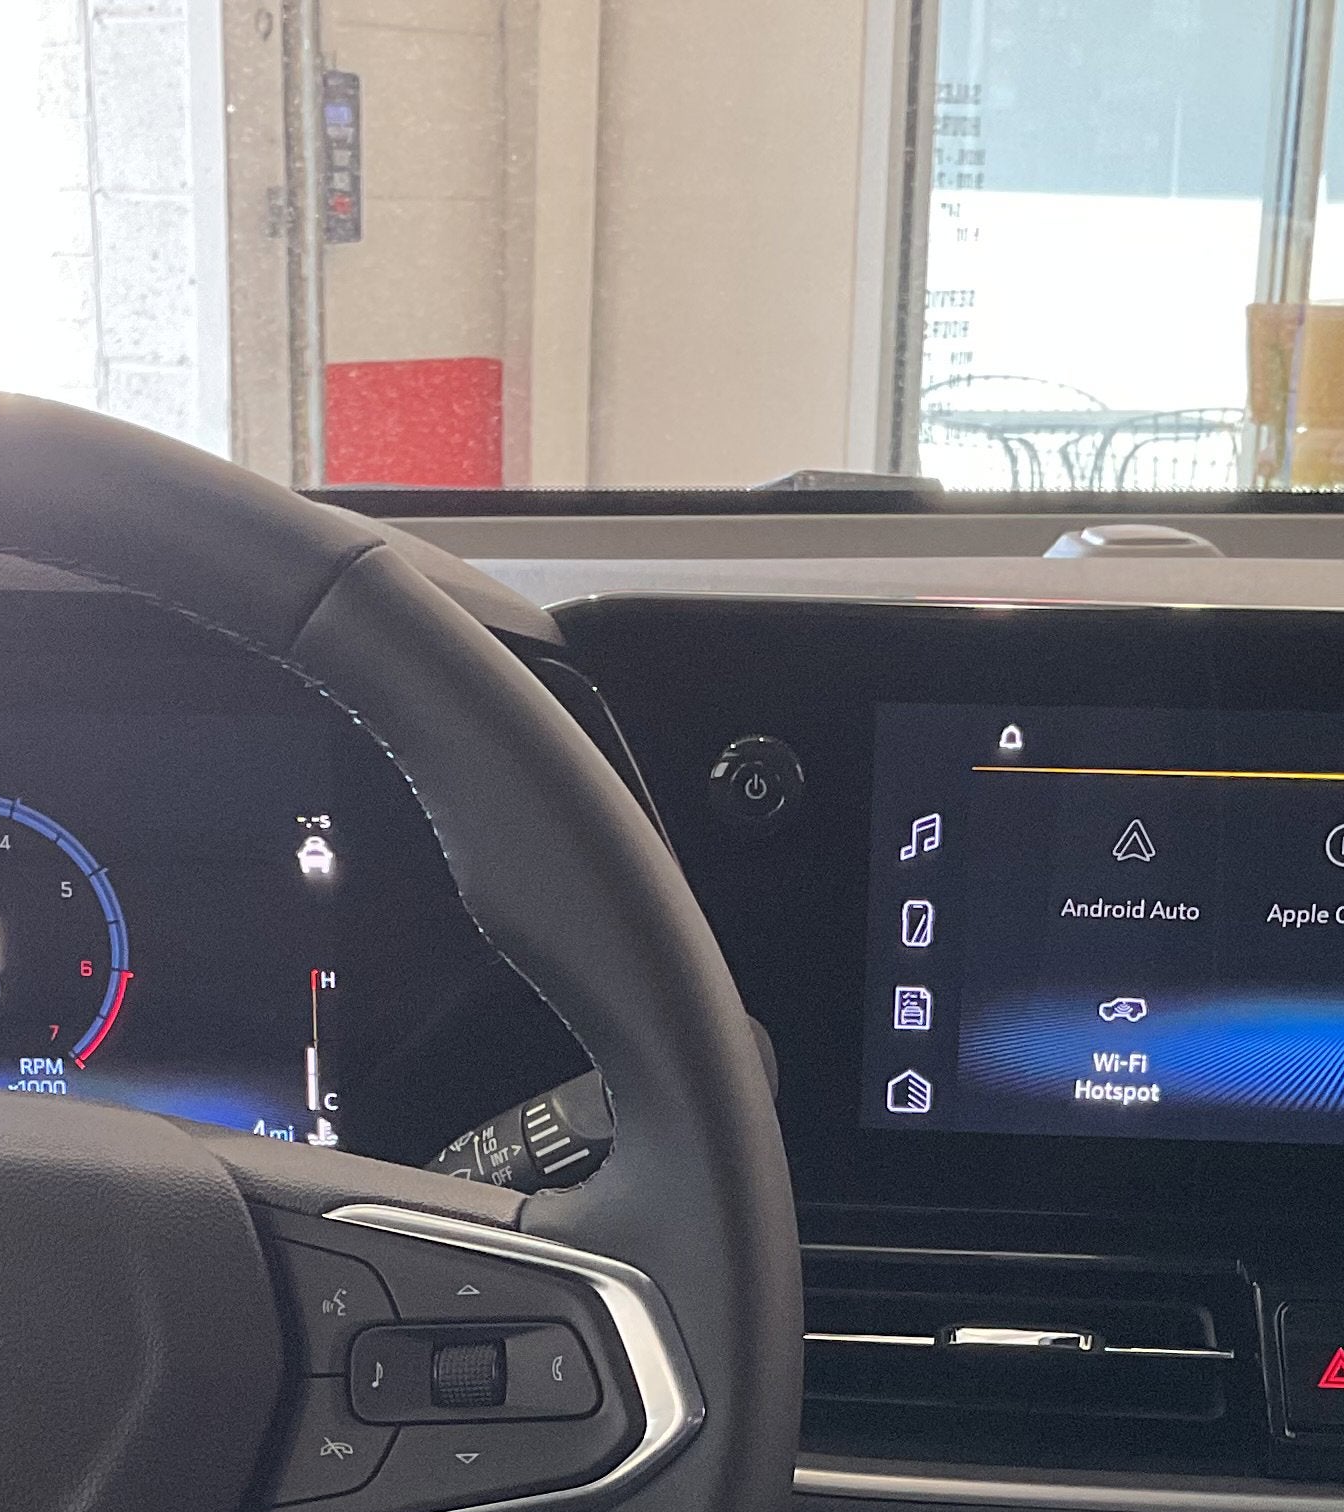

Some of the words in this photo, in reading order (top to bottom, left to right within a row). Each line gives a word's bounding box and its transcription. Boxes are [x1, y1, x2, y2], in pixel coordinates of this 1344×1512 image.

[60, 881, 73, 899] 5
[1060, 897, 1145, 921] Android
[1149, 899, 1201, 922] Auto
[1267, 903, 1330, 931] Apple
[80, 959, 93, 977] 6
[320, 972, 337, 989] H
[49, 1024, 60, 1041] 7
[19, 1057, 64, 1076] RPM
[1093, 1053, 1147, 1074] Wi-Fi
[323, 1092, 339, 1111] C
[1074, 1081, 1160, 1105] Hotspot
[269, 1125, 294, 1143] mi
[482, 1126, 494, 1141] HI
[482, 1137, 498, 1155] LO
[491, 1147, 509, 1167] INT
[492, 1166, 513, 1186] OFF
